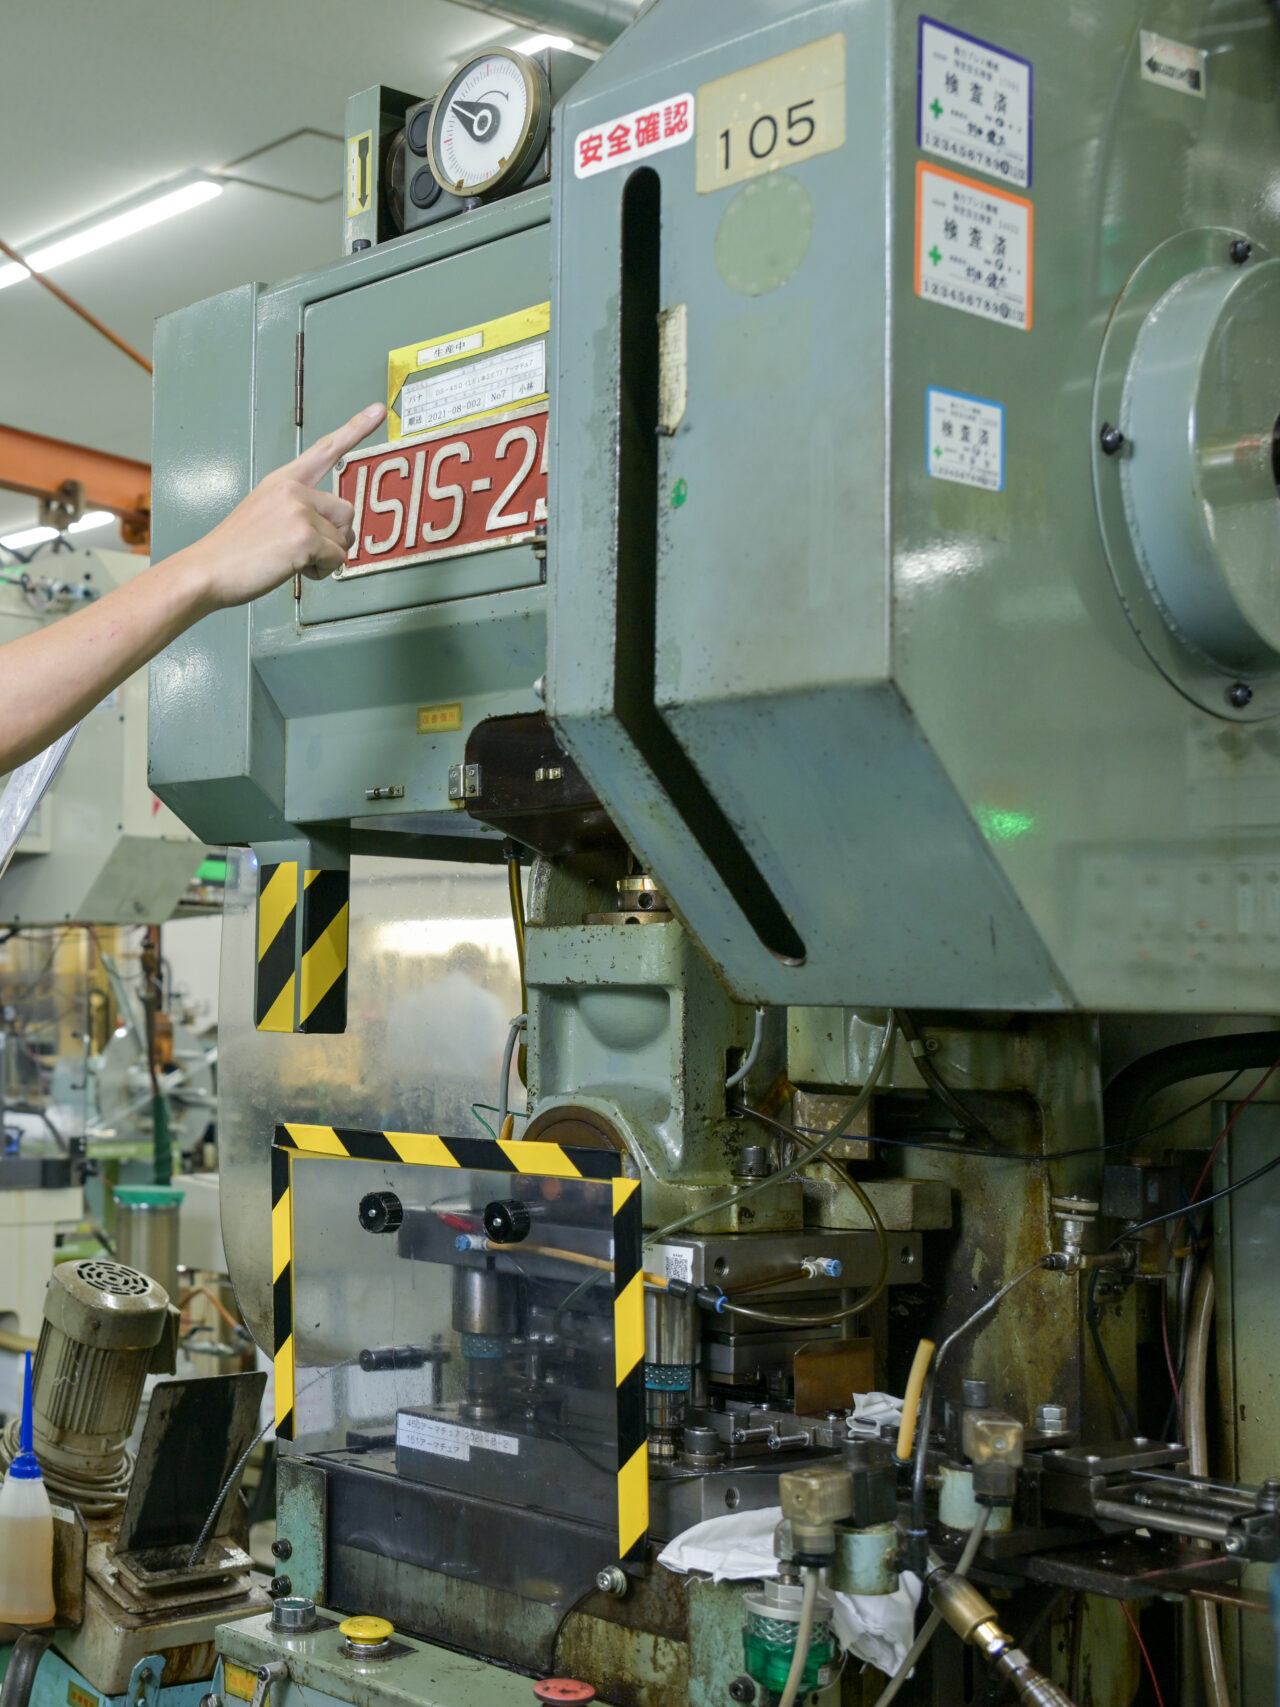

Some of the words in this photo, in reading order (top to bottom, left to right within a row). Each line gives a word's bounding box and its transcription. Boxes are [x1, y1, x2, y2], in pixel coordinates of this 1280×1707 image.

[945, 71, 1008, 115] 検査済
[579, 100, 689, 168] 安全確認
[719, 99, 815, 170] 105
[944, 216, 1007, 257] 検査済
[434, 340, 466, 358] 生産中
[427, 398, 482, 423] 2021-08-002
